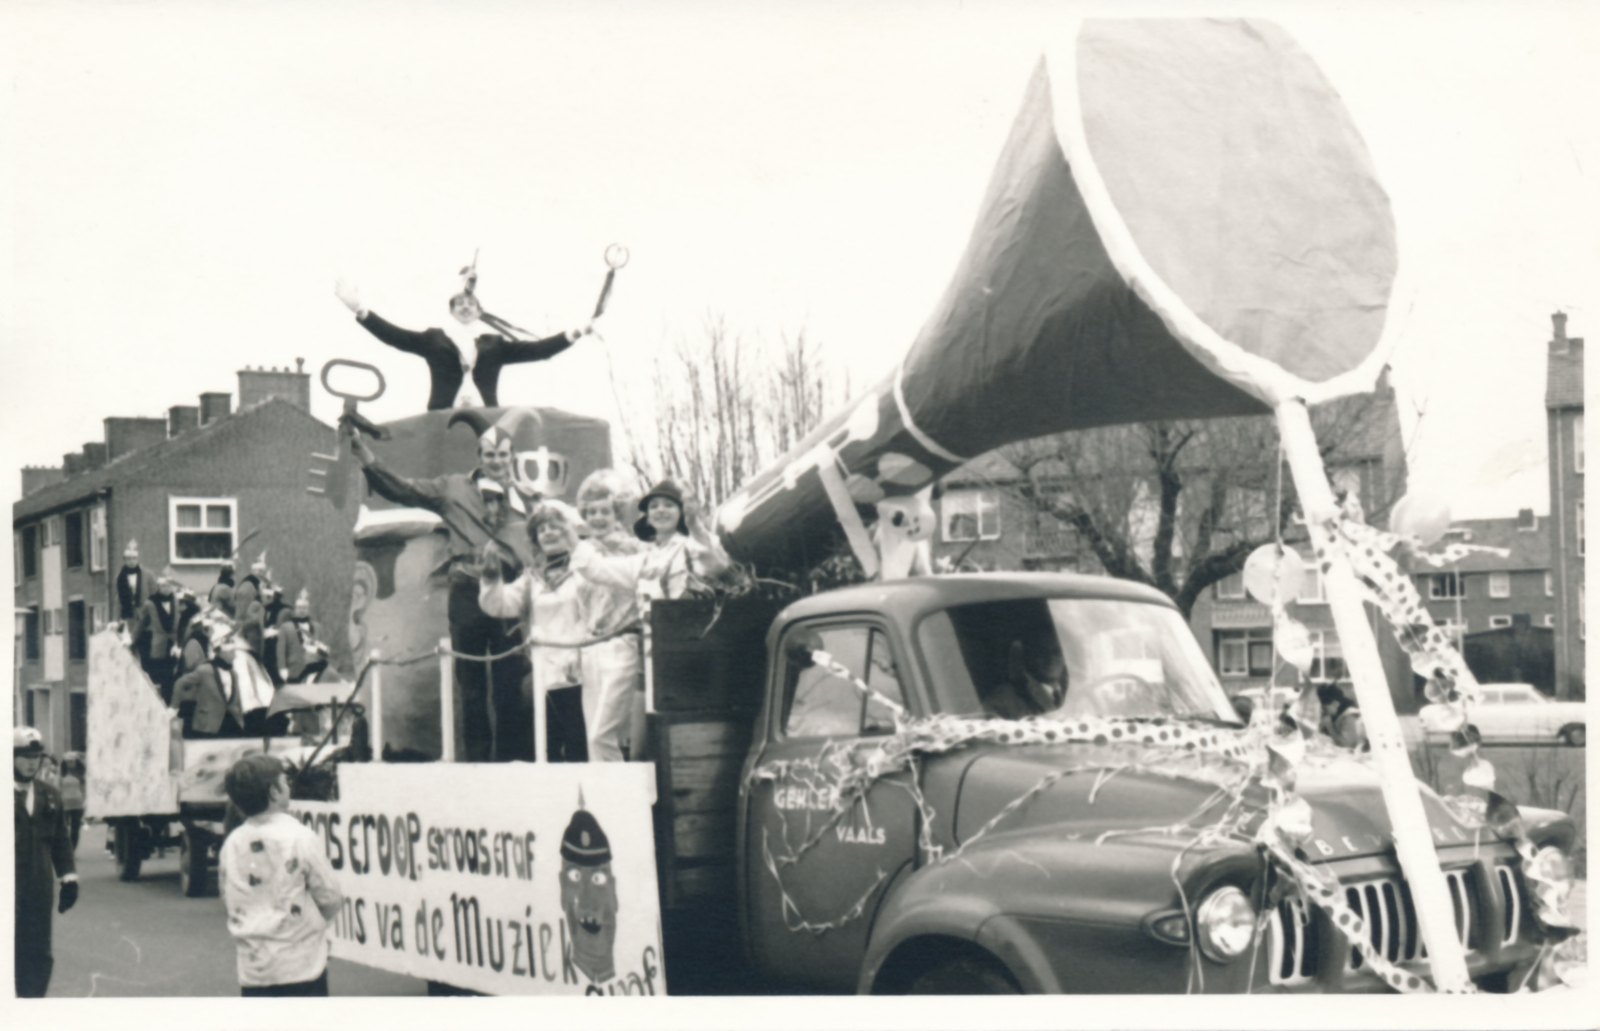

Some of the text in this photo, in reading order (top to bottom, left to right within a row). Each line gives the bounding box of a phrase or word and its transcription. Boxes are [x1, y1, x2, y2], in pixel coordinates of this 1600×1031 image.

[836, 826, 886, 845] VAALS
[374, 901, 405, 951] va
[414, 898, 446, 961] de
